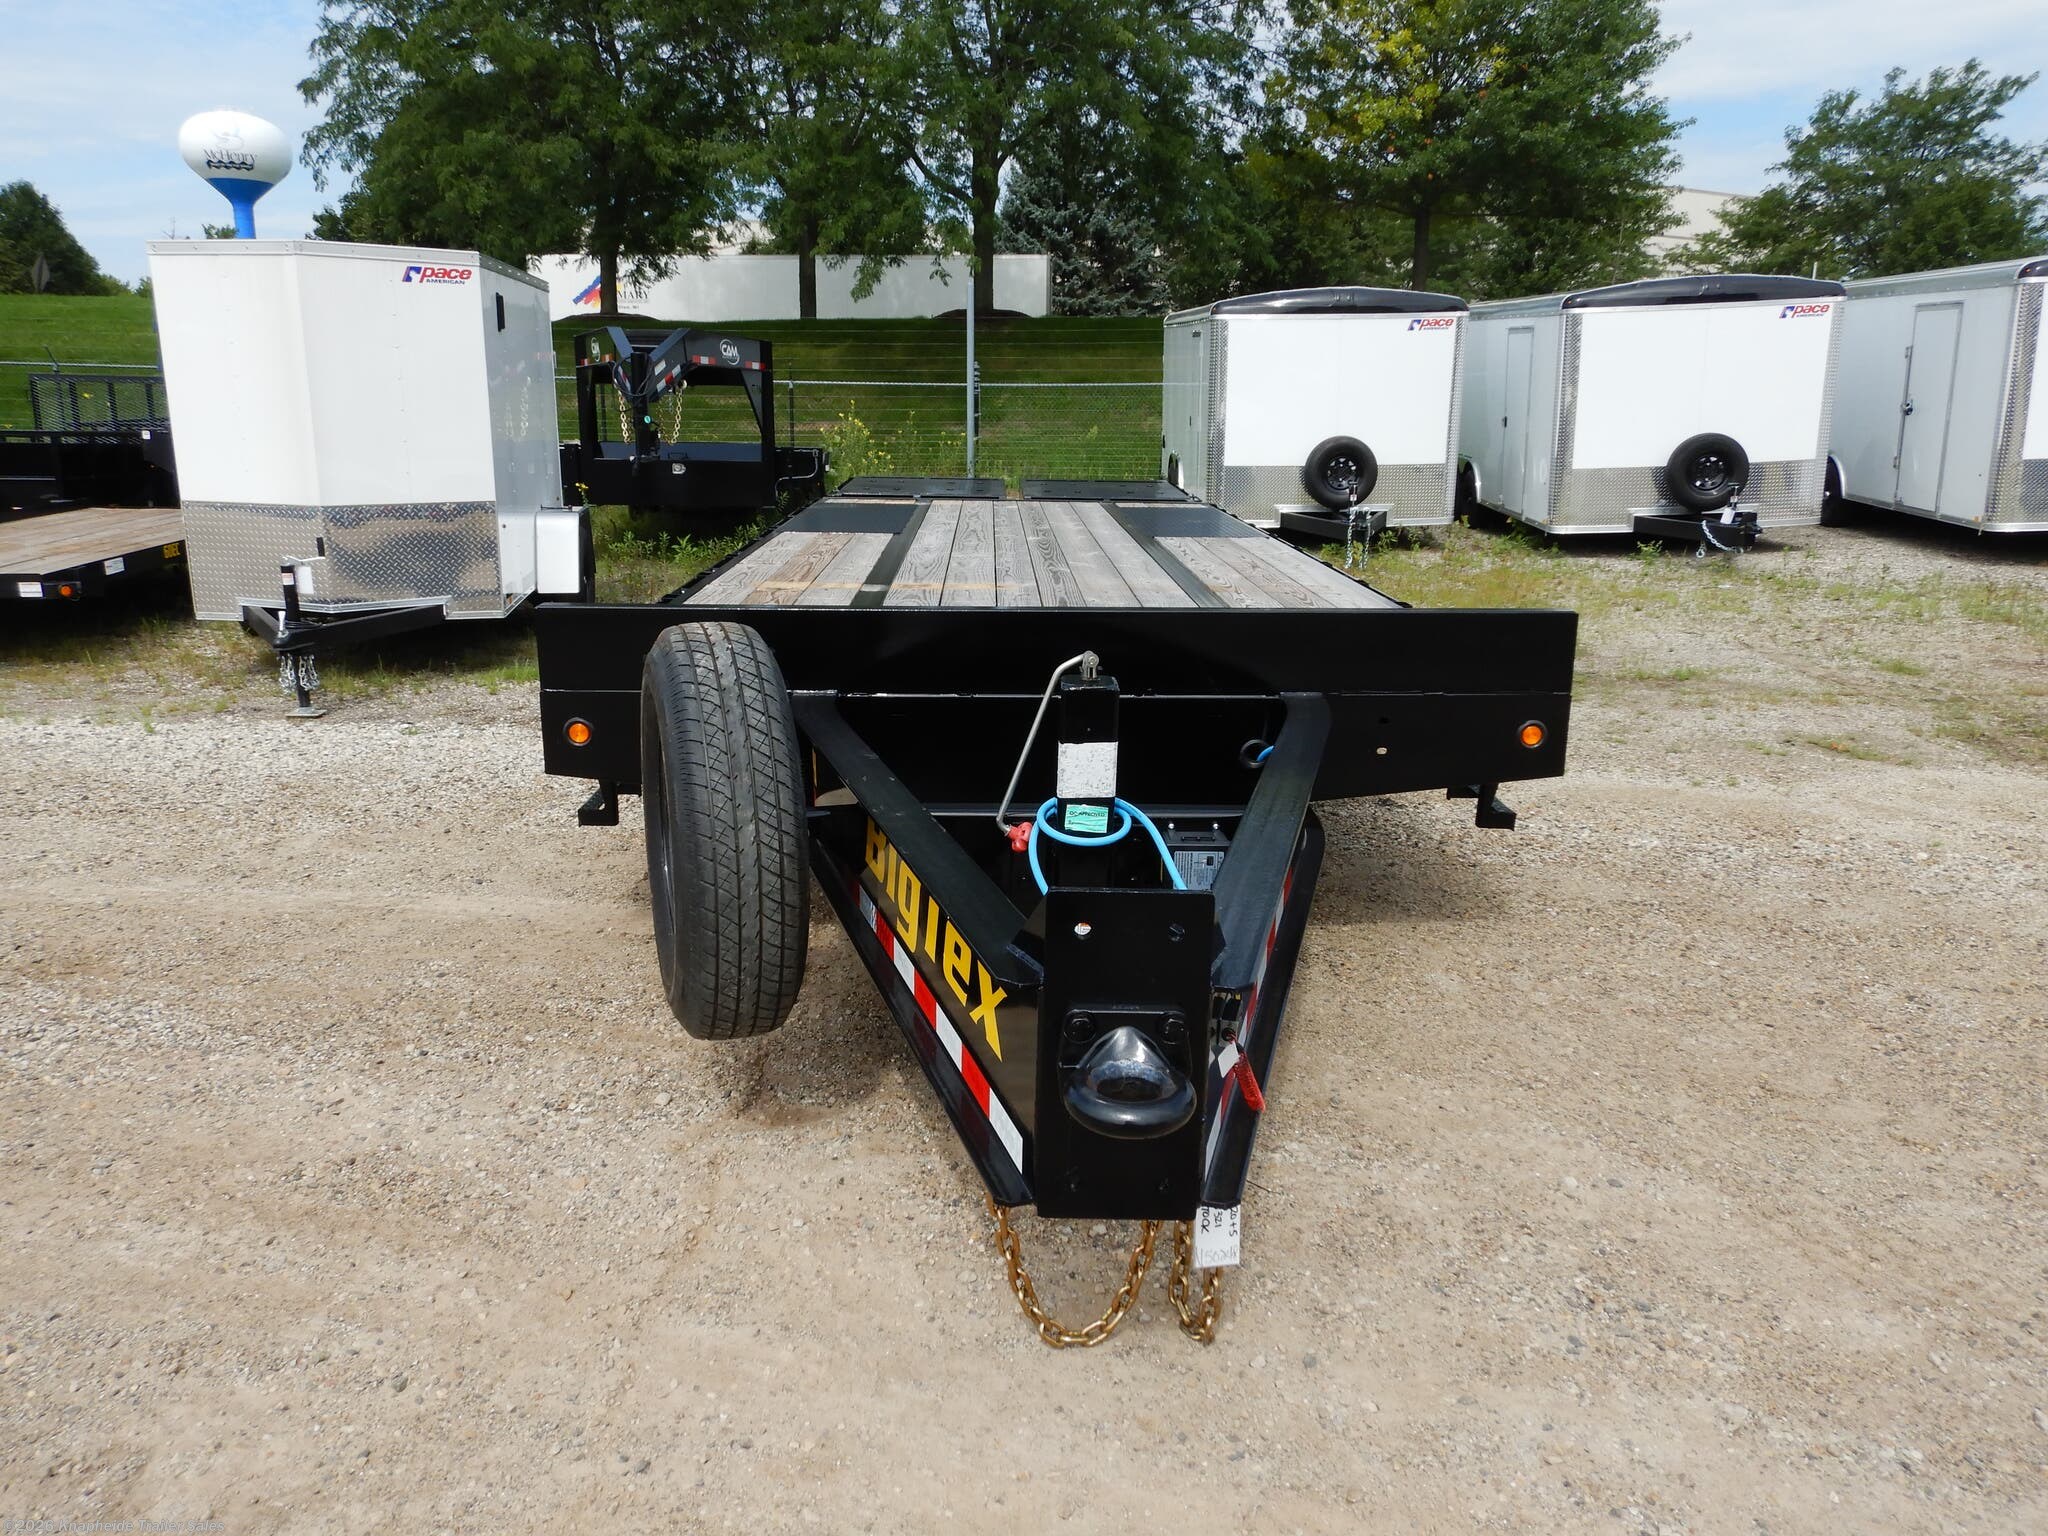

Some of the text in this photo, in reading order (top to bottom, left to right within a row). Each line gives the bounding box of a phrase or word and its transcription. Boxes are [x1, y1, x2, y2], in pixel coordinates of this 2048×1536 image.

[419, 267, 472, 283] pace
[618, 290, 648, 299] MARY
[1791, 304, 1830, 318] pace
[1419, 319, 1454, 331] pace
[721, 344, 738, 357] CAM
[1201, 1206, 1210, 1234] TOCK
